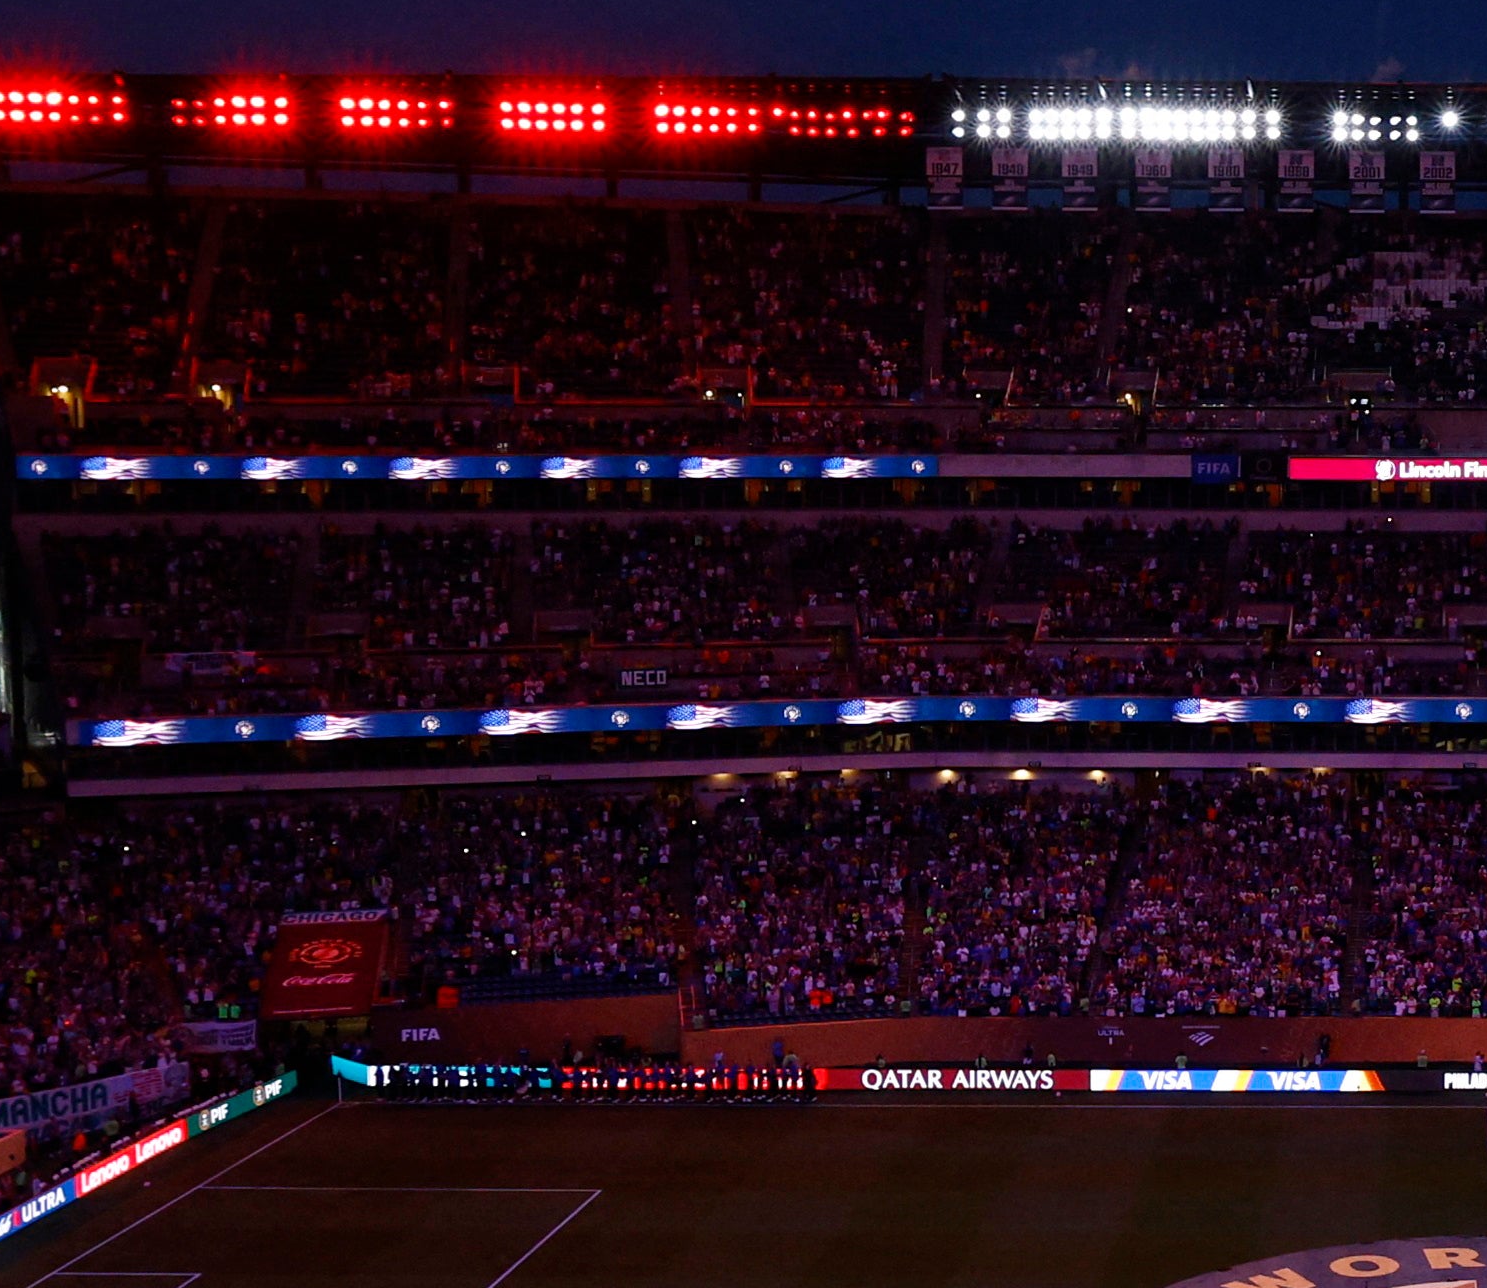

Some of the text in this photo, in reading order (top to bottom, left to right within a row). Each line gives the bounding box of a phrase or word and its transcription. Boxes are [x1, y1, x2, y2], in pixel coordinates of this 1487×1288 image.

[1354, 166, 1380, 178] 2001
[1423, 167, 1453, 179] 2002
[1197, 462, 1230, 474] FIFA
[1400, 461, 1461, 478] Lincoln
[282, 911, 378, 924] CHICAGO
[401, 1027, 440, 1042] FIFA
[264, 1079, 283, 1099] PIF
[861, 1070, 1054, 1090] QATAR AIRWAYS
[1140, 1070, 1192, 1090] VISA
[1271, 1070, 1321, 1090] VISA
[210, 1104, 230, 1124] PIF
[134, 1127, 182, 1163] Lenovo
[80, 1155, 130, 1192] Lenovo
[21, 1187, 66, 1223] ULTRA
